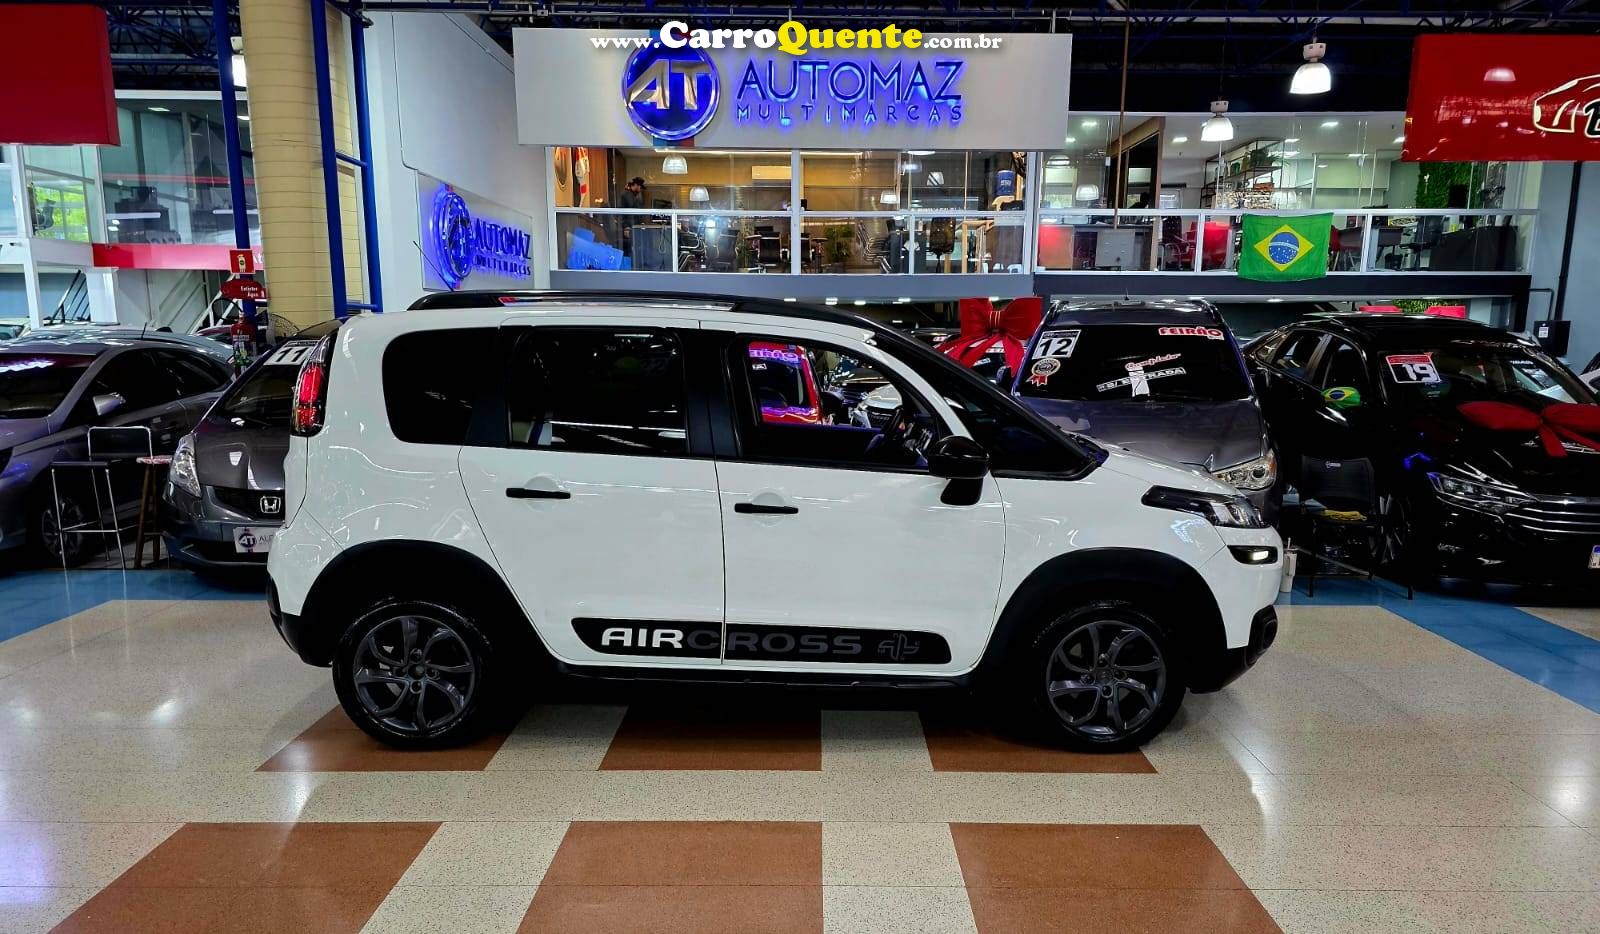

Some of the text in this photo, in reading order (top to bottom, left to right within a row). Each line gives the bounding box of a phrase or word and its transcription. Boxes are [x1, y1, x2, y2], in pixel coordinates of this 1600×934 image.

[625, 58, 712, 110] AT
[737, 59, 963, 100] AUTOMAZ
[737, 103, 962, 122] MULTIMARCAS
[474, 217, 531, 260] AUTOMAZ
[1158, 326, 1224, 337] FEIRÃO
[275, 347, 310, 362] 11
[1039, 338, 1073, 357] 12
[1402, 364, 1438, 382] 19
[601, 627, 862, 655] AIRCROSS
